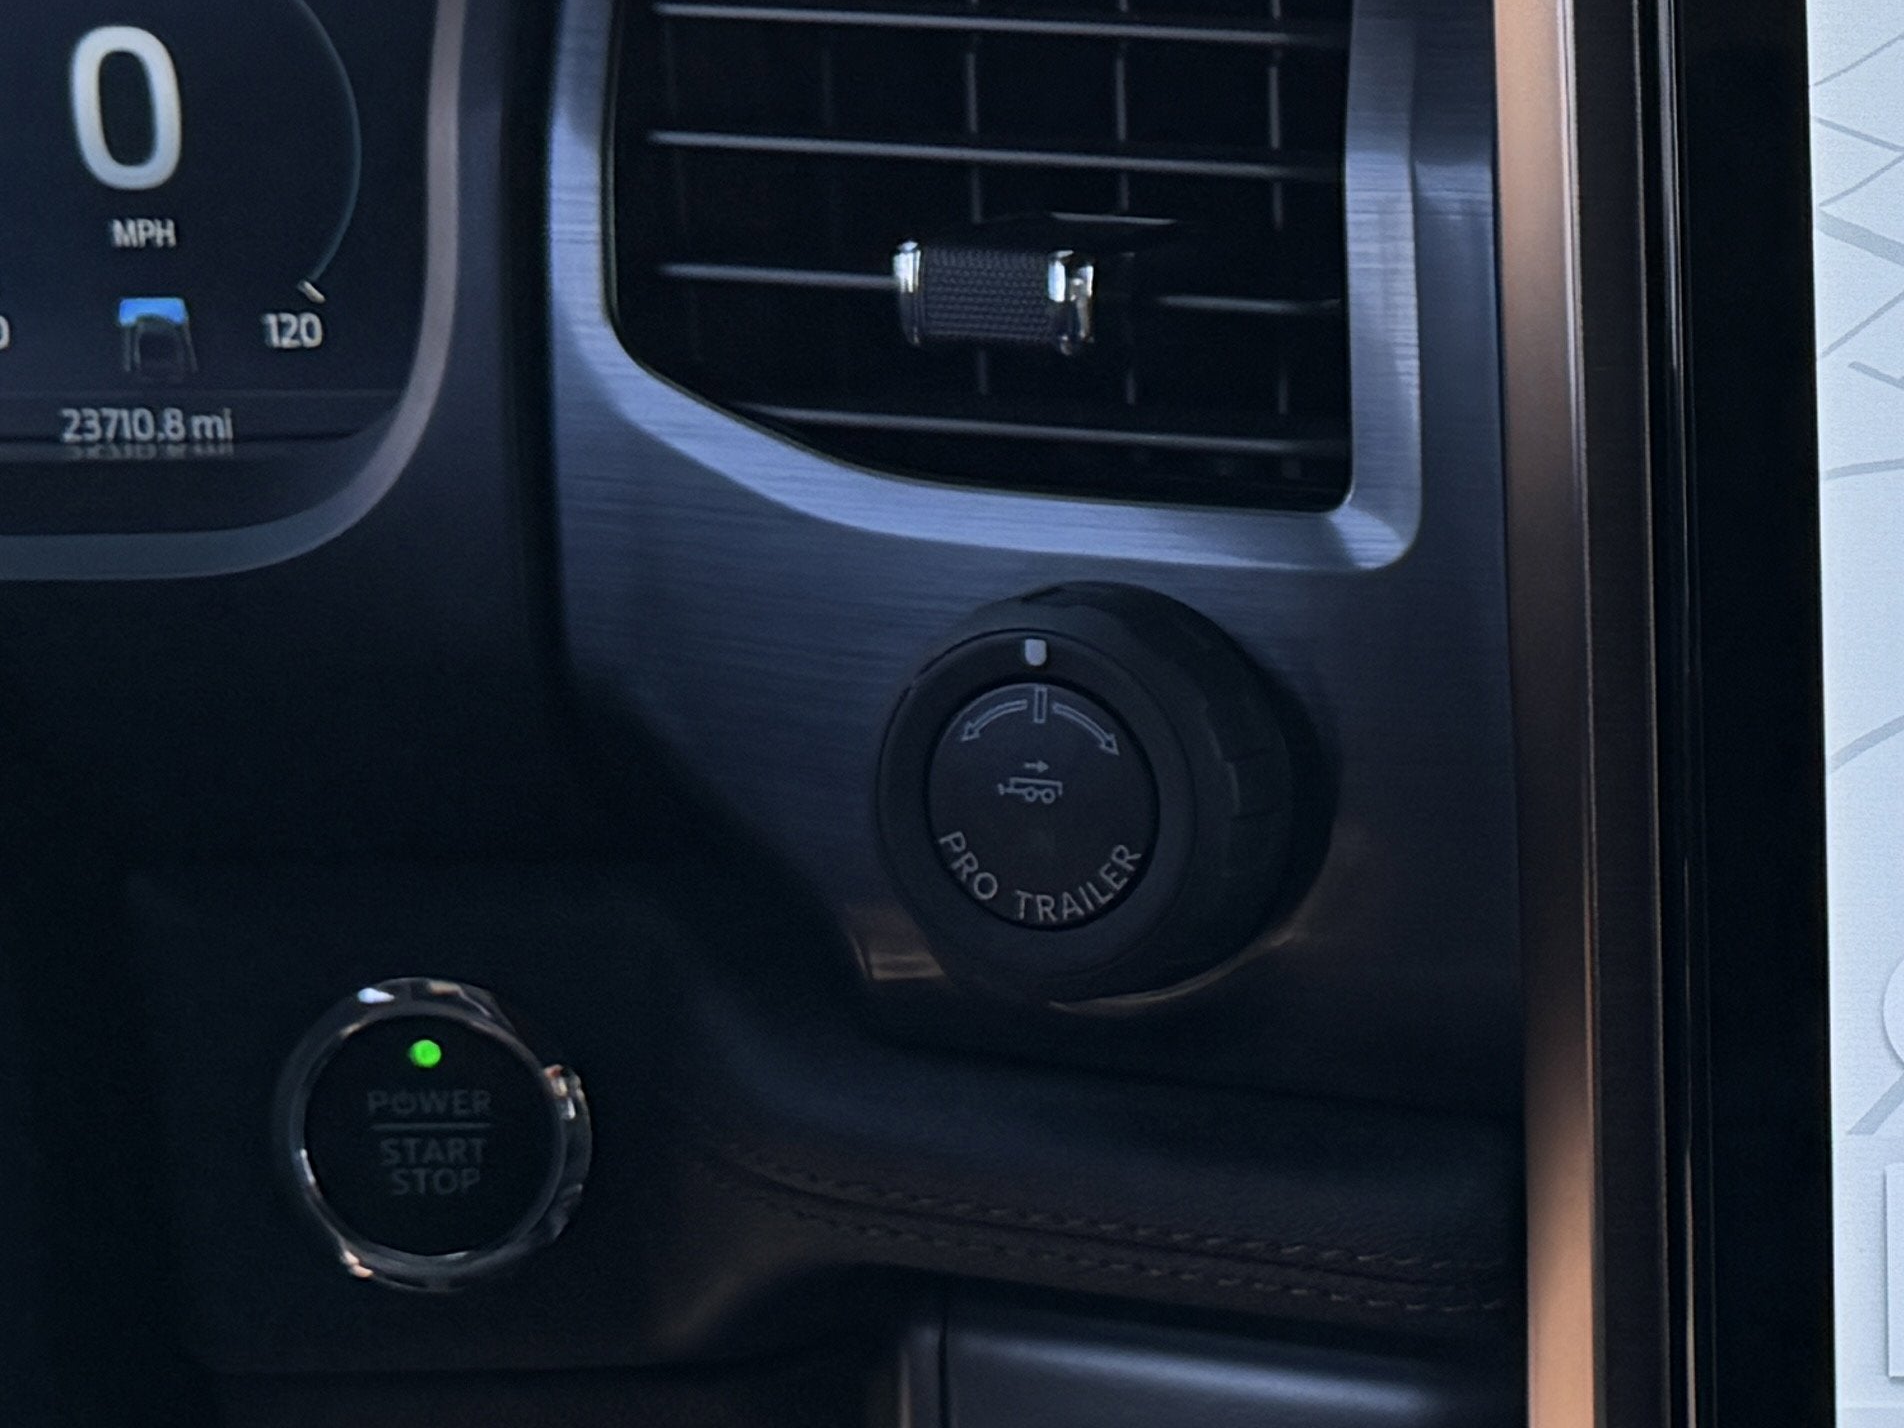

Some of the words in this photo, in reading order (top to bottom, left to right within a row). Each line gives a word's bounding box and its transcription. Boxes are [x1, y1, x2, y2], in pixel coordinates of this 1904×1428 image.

[71, 25, 181, 189] 0
[111, 218, 176, 246] MPH
[265, 312, 323, 348] 120
[61, 407, 186, 443] 23710.8
[190, 409, 233, 440] mi
[938, 831, 999, 901] PRO
[1014, 844, 1141, 922] TRAILER
[367, 1089, 491, 1117] POWER
[379, 1137, 485, 1166] START
[390, 1167, 480, 1195] STOP
